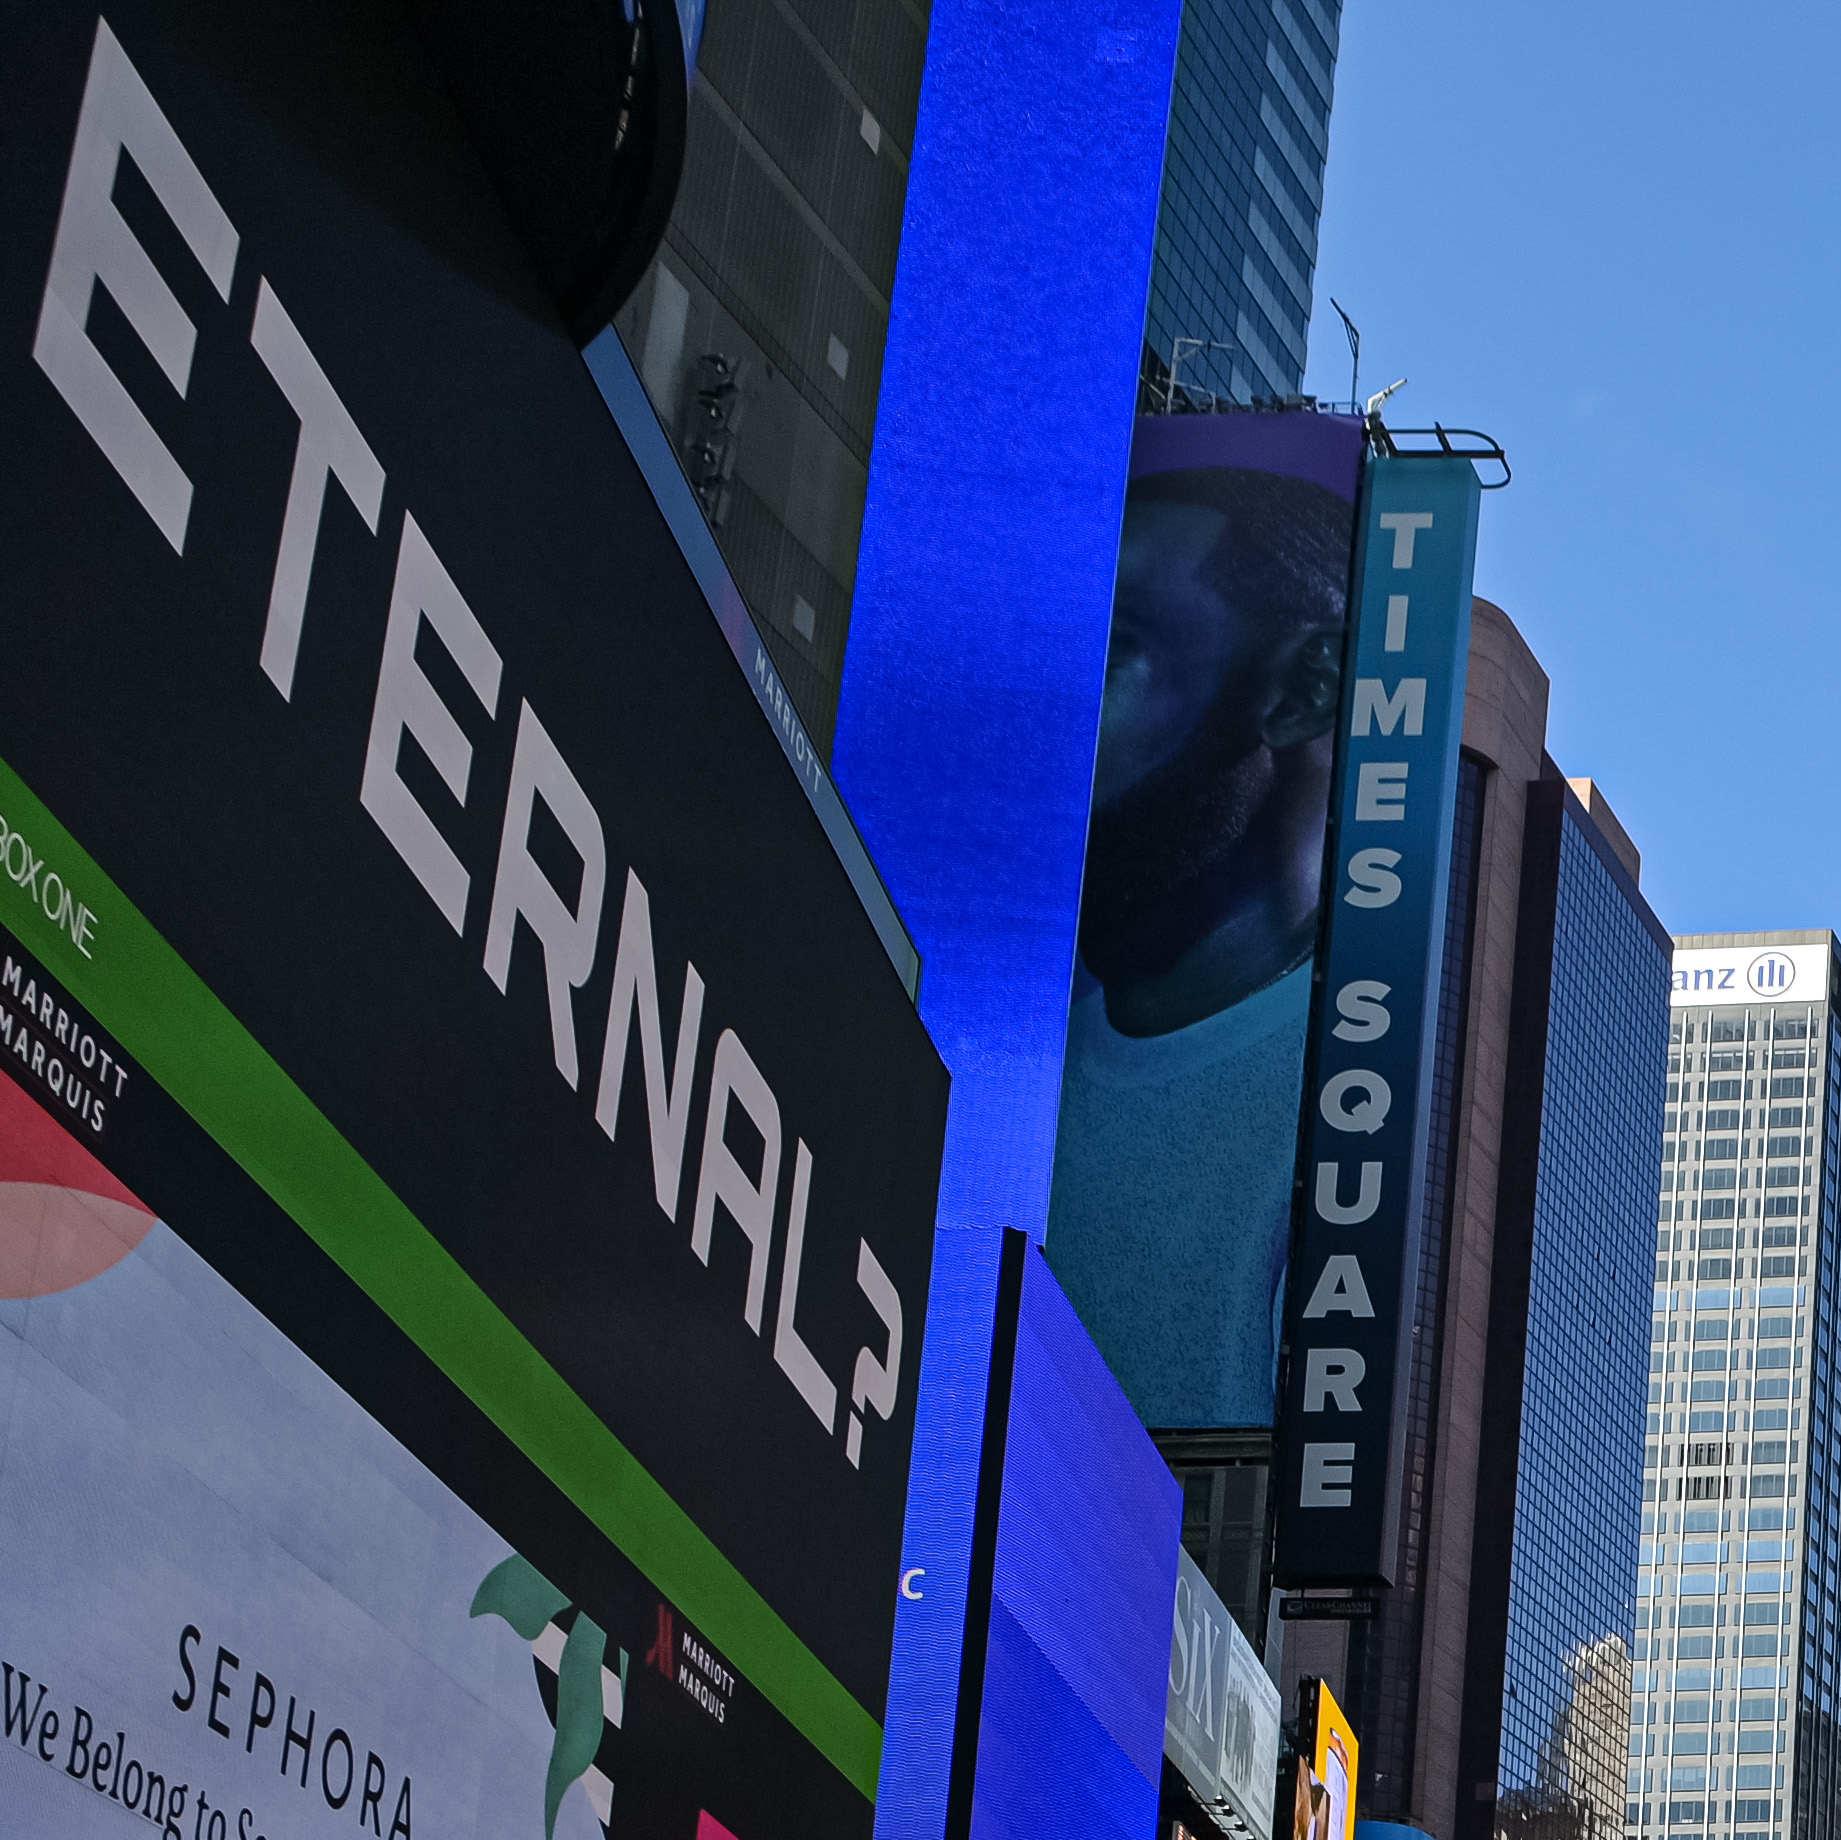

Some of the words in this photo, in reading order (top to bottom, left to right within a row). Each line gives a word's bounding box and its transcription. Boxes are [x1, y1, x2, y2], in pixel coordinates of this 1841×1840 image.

[33, 15, 903, 1470] ETERNAL?
[753, 647, 823, 793] MARRIOTT
[1350, 512, 1433, 908] TIMES
[41, 872, 99, 960] ONE
[0, 1005, 105, 1133] MARQUIS
[3, 955, 128, 1098] MARRIOTT
[1300, 980, 1392, 1507] SQUARE
[1, 1662, 57, 1761] We
[678, 1664, 725, 1724] MARQUIS
[682, 1631, 735, 1698] MARRIOTT
